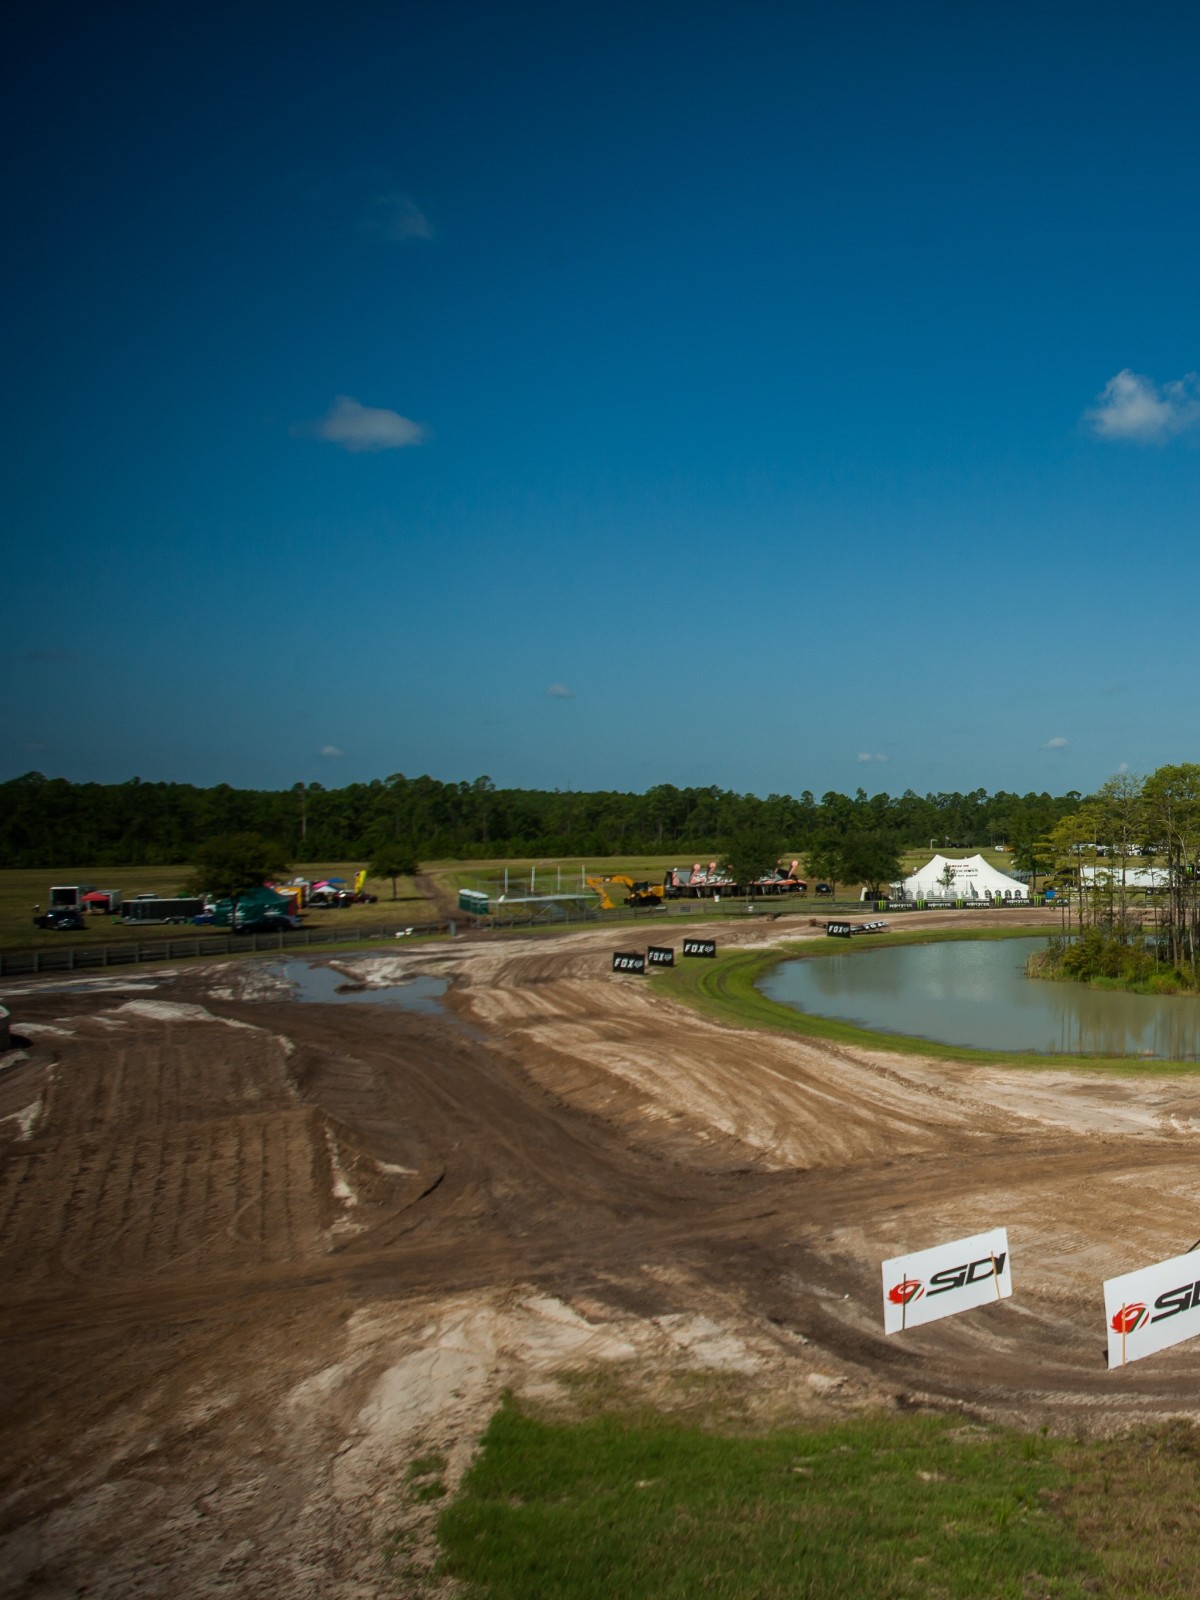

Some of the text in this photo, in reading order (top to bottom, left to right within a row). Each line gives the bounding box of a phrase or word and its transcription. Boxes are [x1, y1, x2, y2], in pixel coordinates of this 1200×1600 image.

[684, 943, 705, 953] FOX
[648, 951, 665, 961] FOX
[614, 958, 635, 968] FOX
[926, 1252, 1007, 1297] SIDI
